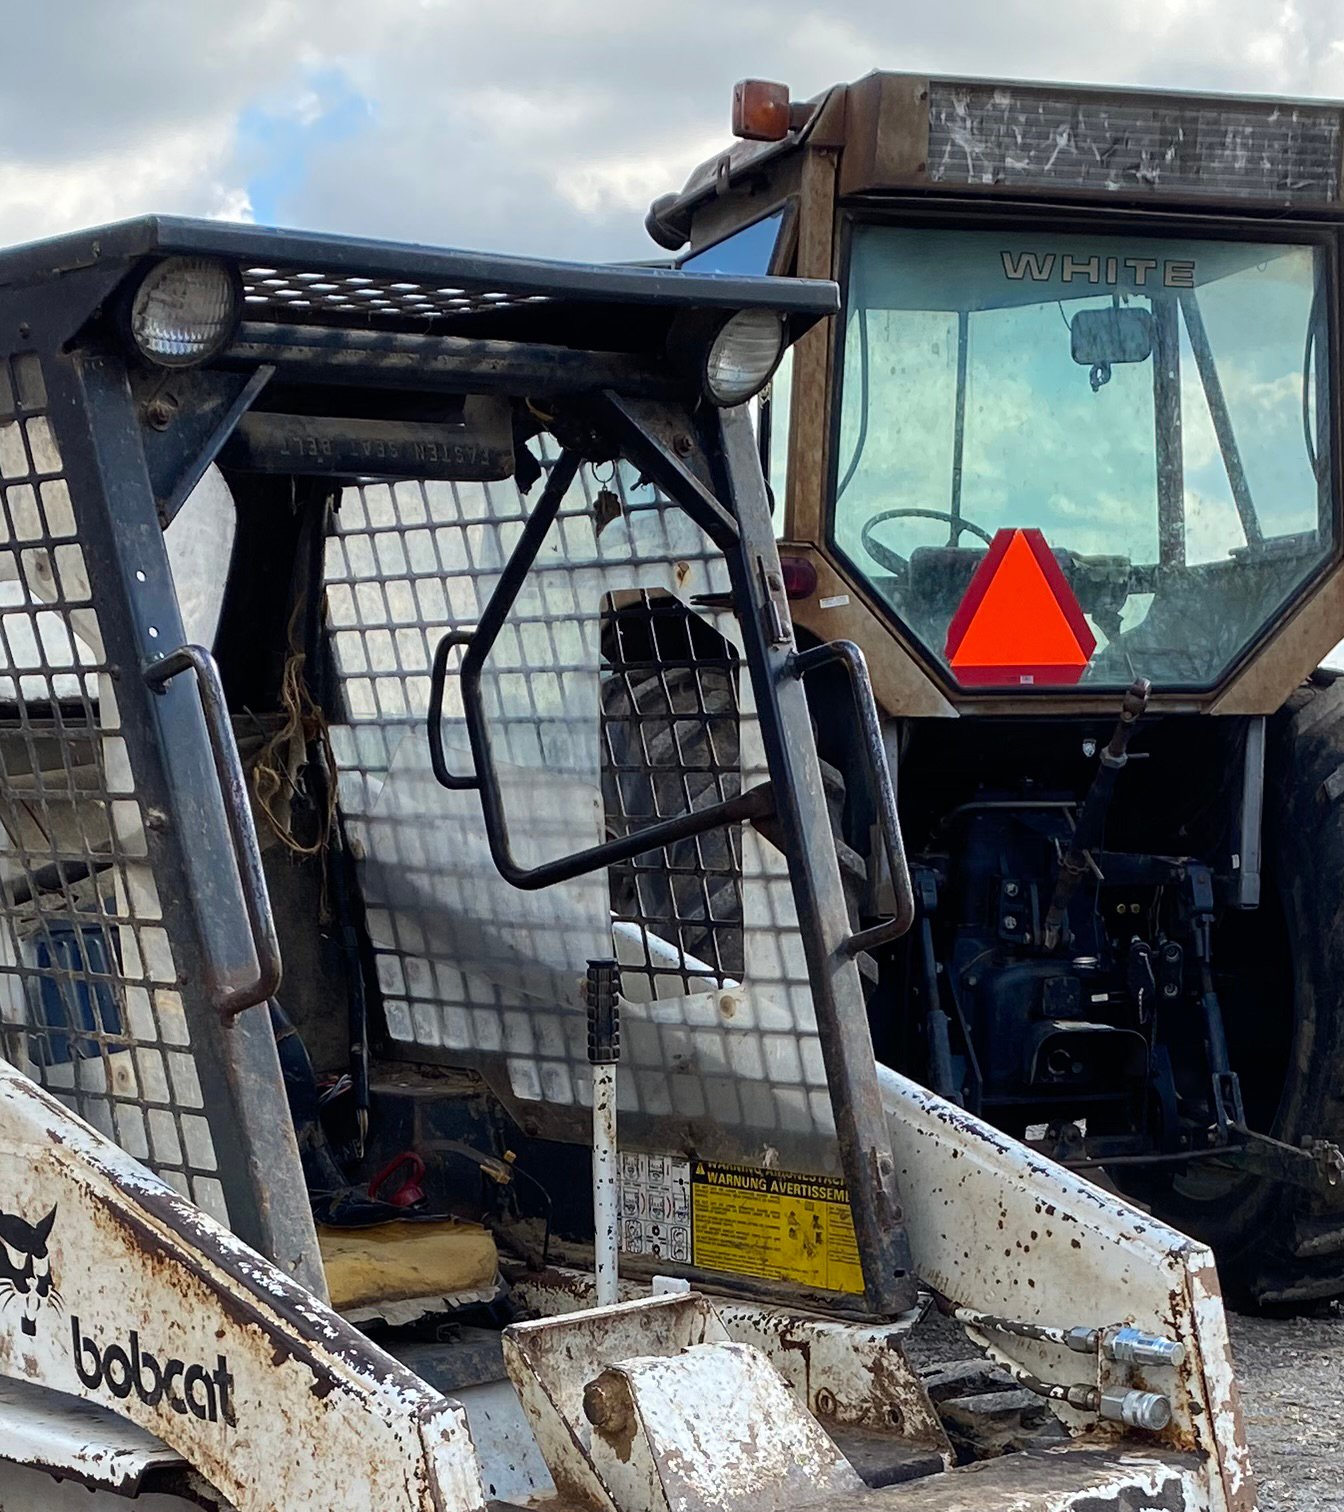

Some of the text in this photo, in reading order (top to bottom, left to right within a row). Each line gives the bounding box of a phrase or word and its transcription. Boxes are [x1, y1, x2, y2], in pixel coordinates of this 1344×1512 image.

[1000, 251, 1196, 288] WHITE
[280, 436, 490, 465] FASTEN SEAT BELT
[707, 1171, 767, 1191] WARNUNG
[70, 1315, 237, 1428] bobcat
